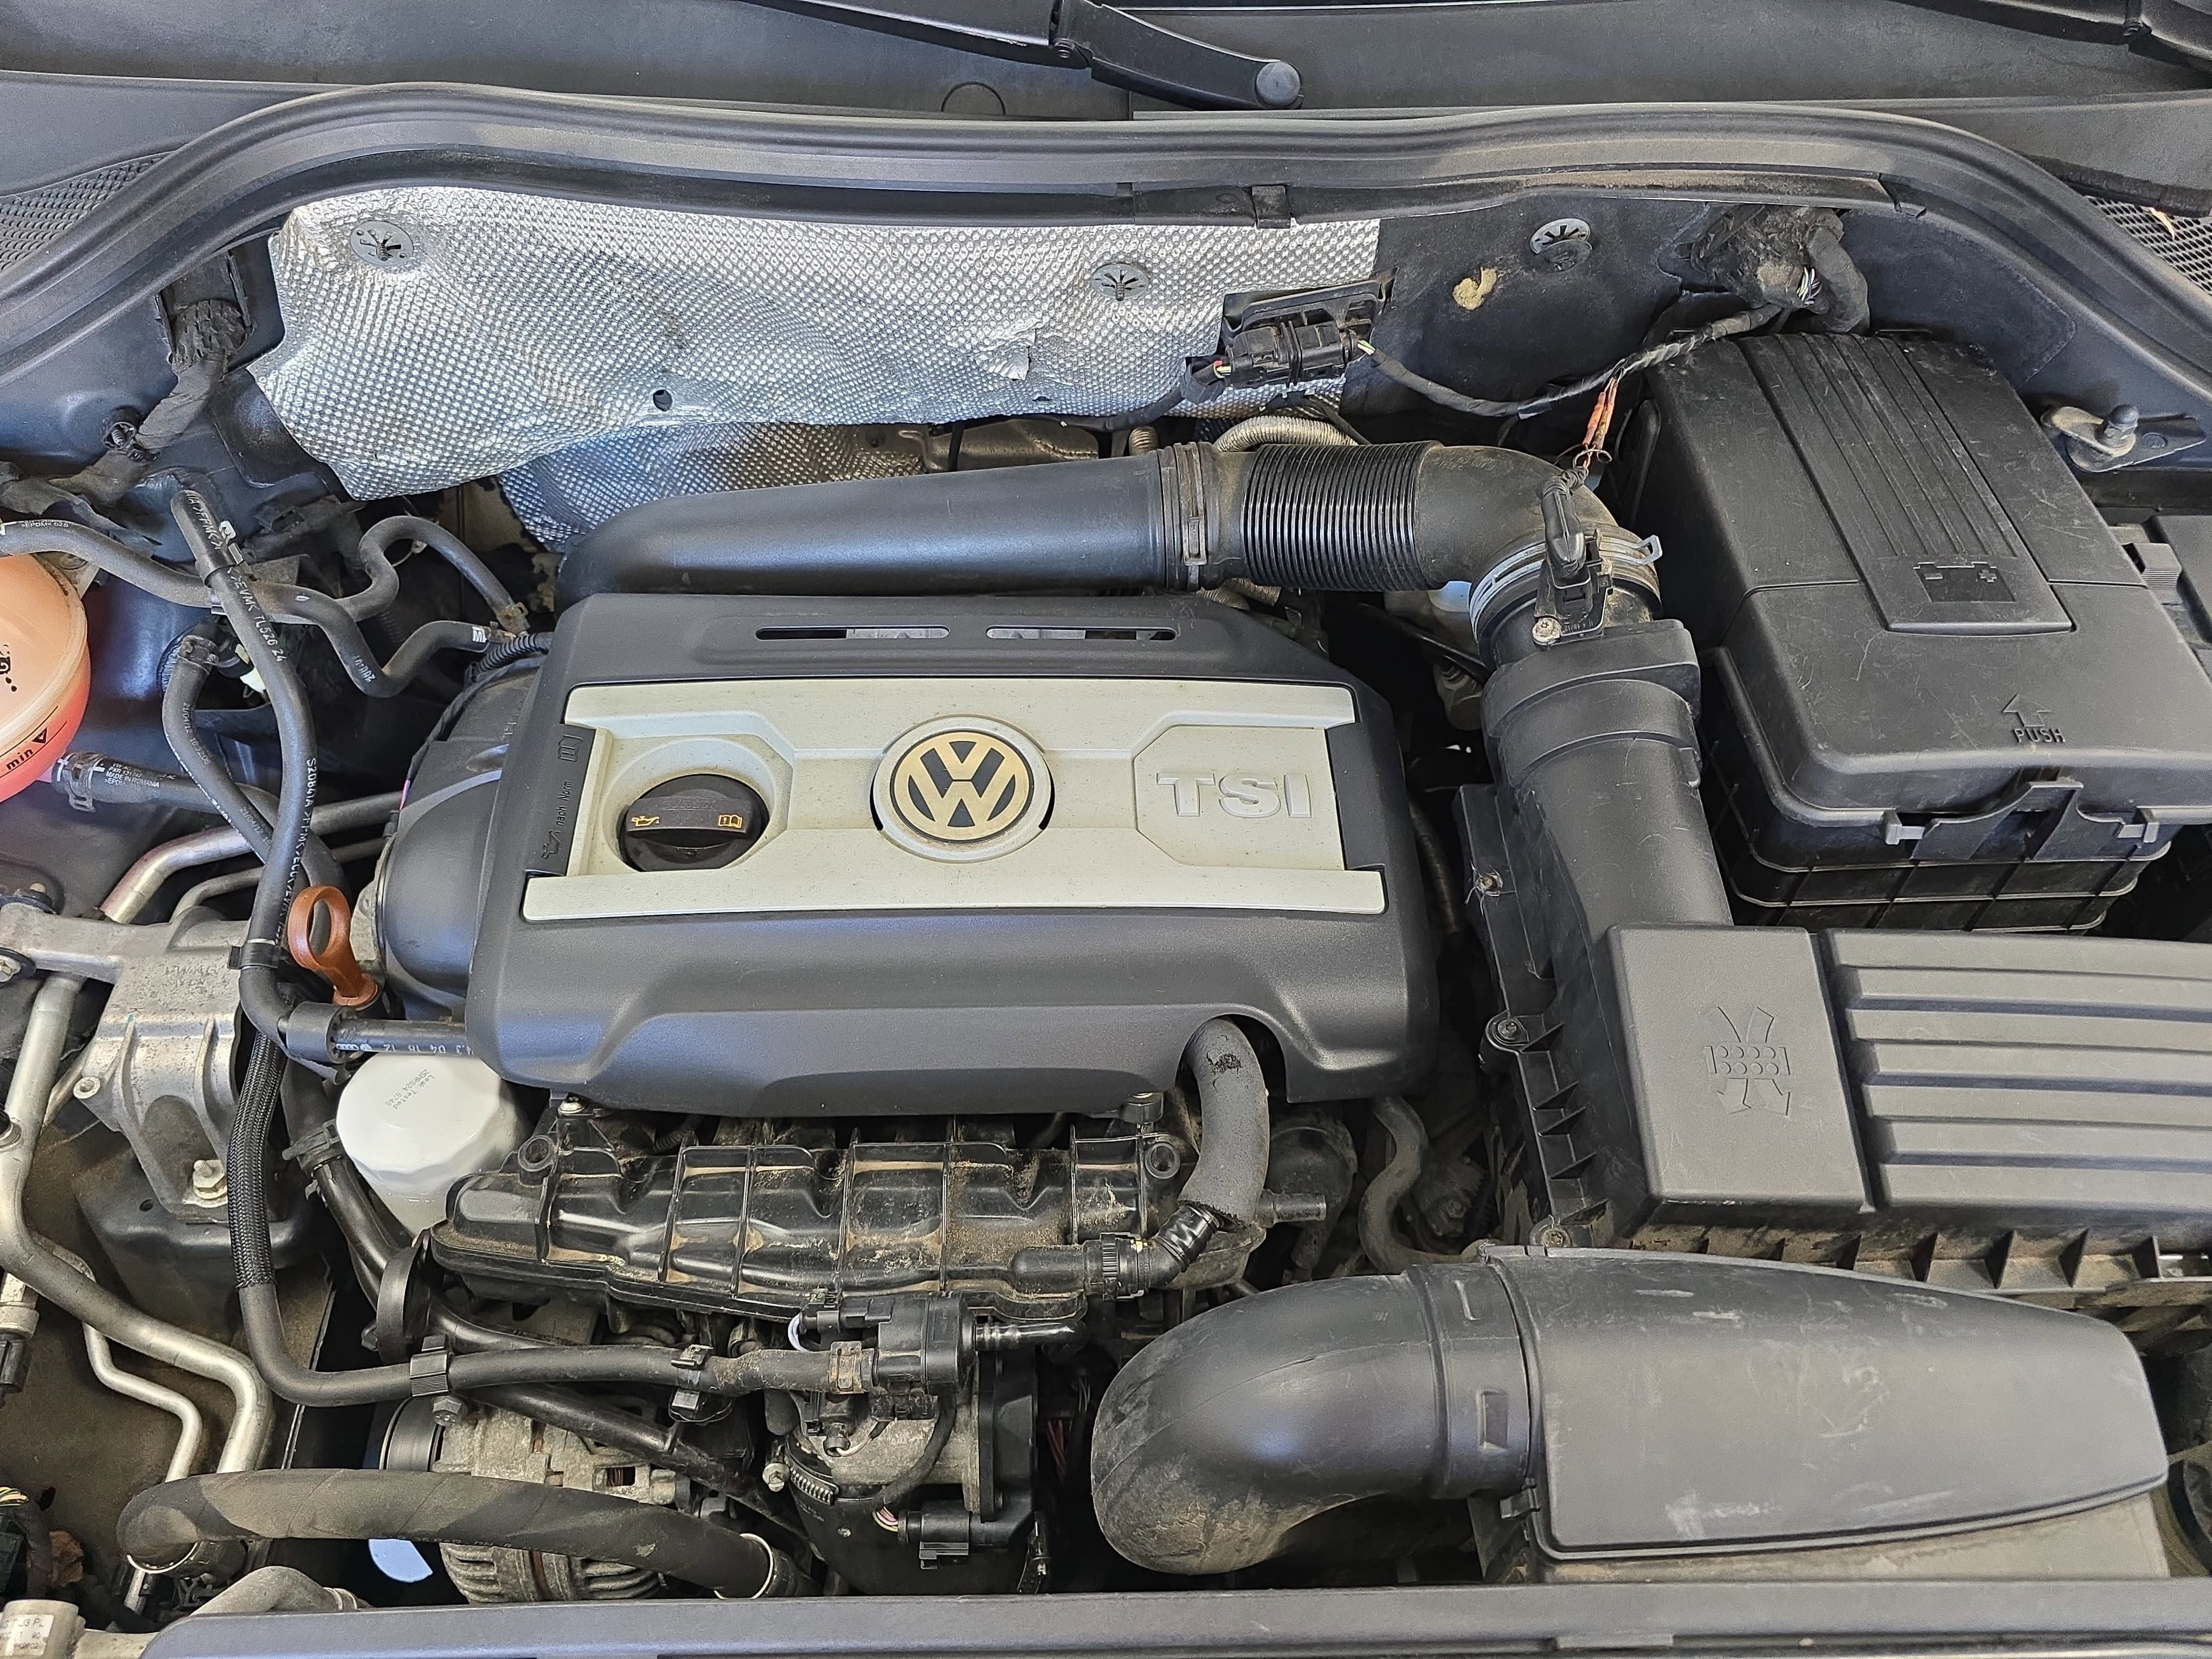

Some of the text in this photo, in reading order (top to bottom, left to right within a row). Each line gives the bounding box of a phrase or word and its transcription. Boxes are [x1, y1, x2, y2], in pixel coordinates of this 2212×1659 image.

[2012, 728, 2066, 743] PUSH
[6, 749, 34, 770] min
[106, 771, 124, 780] MADE
[555, 780, 573, 826] nach Norm
[1156, 772, 1313, 818] TSI
[393, 1075, 435, 1110] Leak Tested
